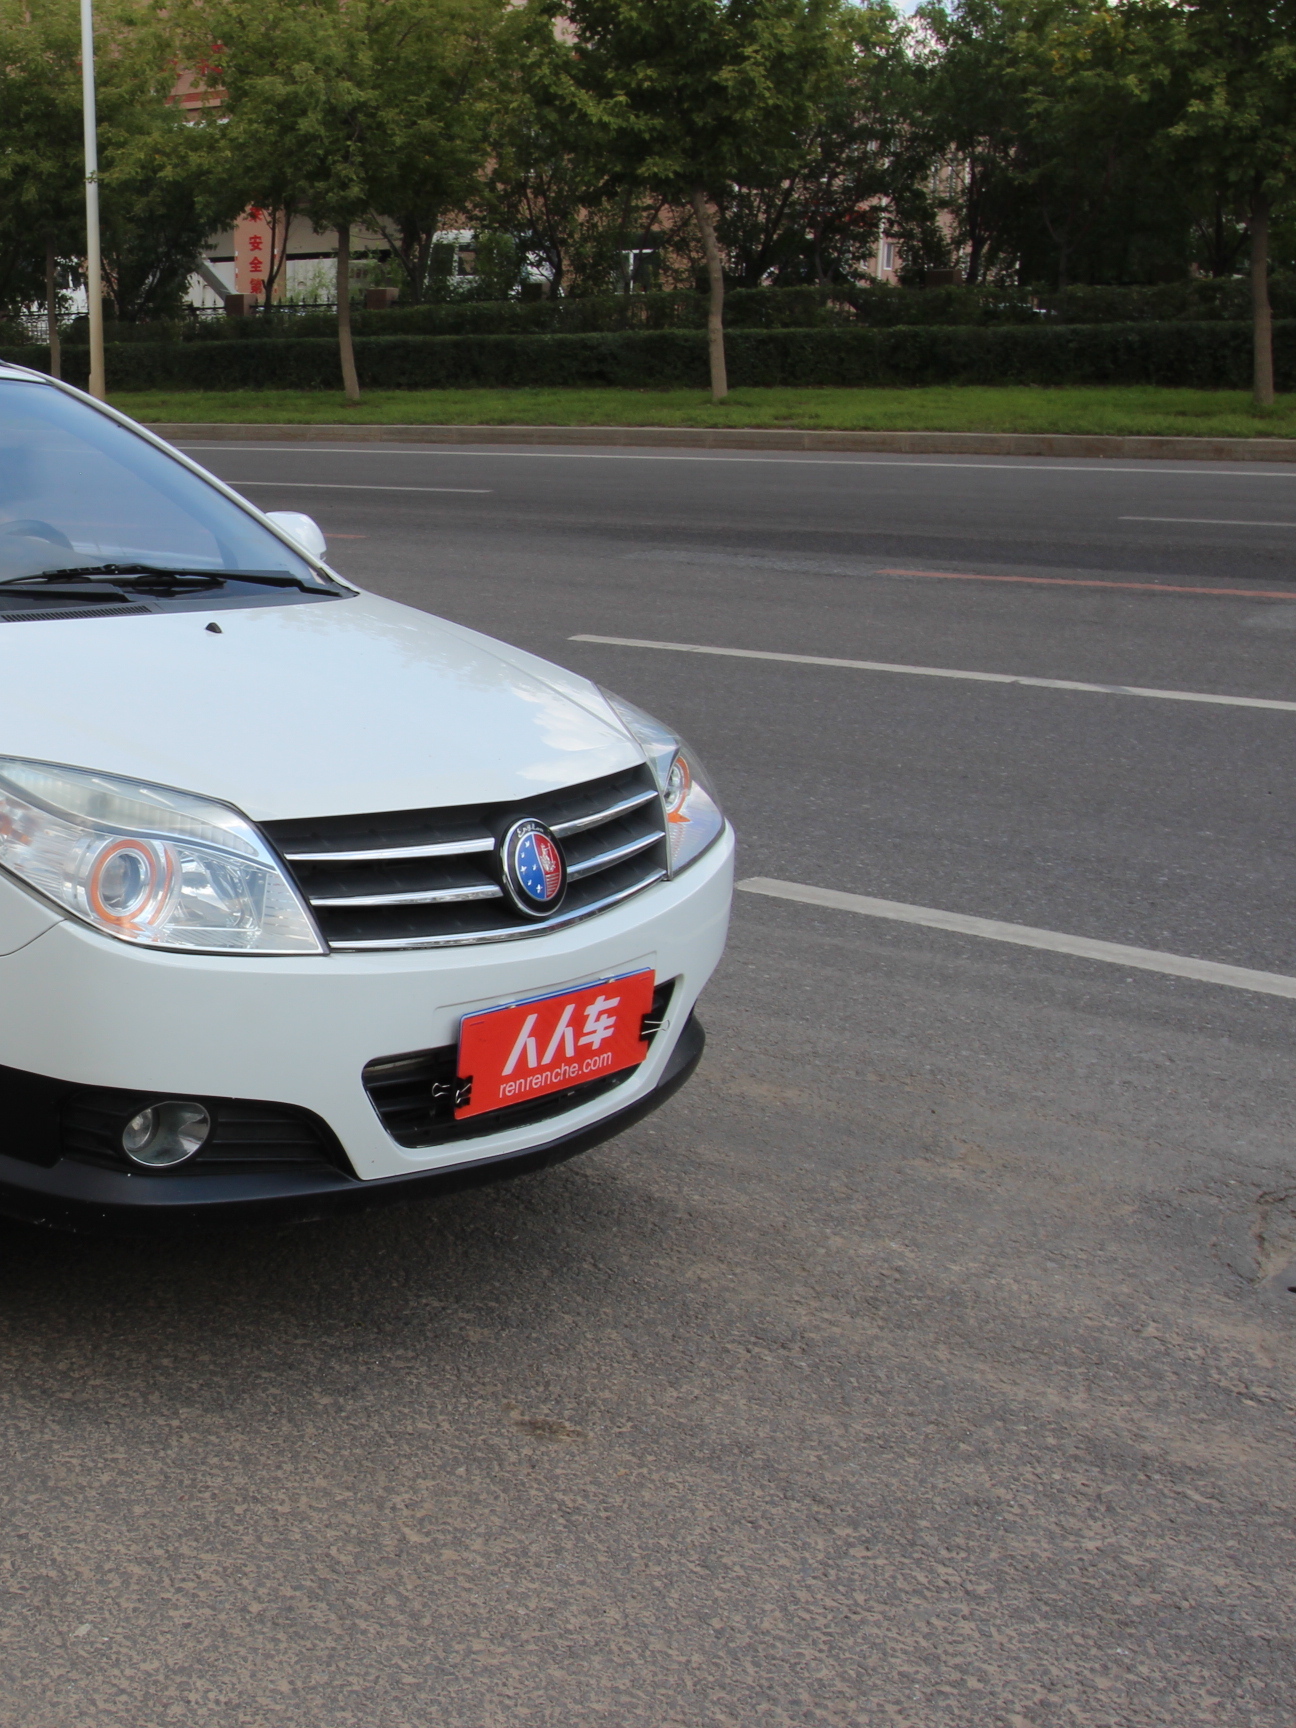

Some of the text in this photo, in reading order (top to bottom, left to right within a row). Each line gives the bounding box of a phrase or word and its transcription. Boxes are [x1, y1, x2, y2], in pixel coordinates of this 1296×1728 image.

[501, 994, 621, 1076] 人人车
[499, 1051, 612, 1098] renrenche.com
